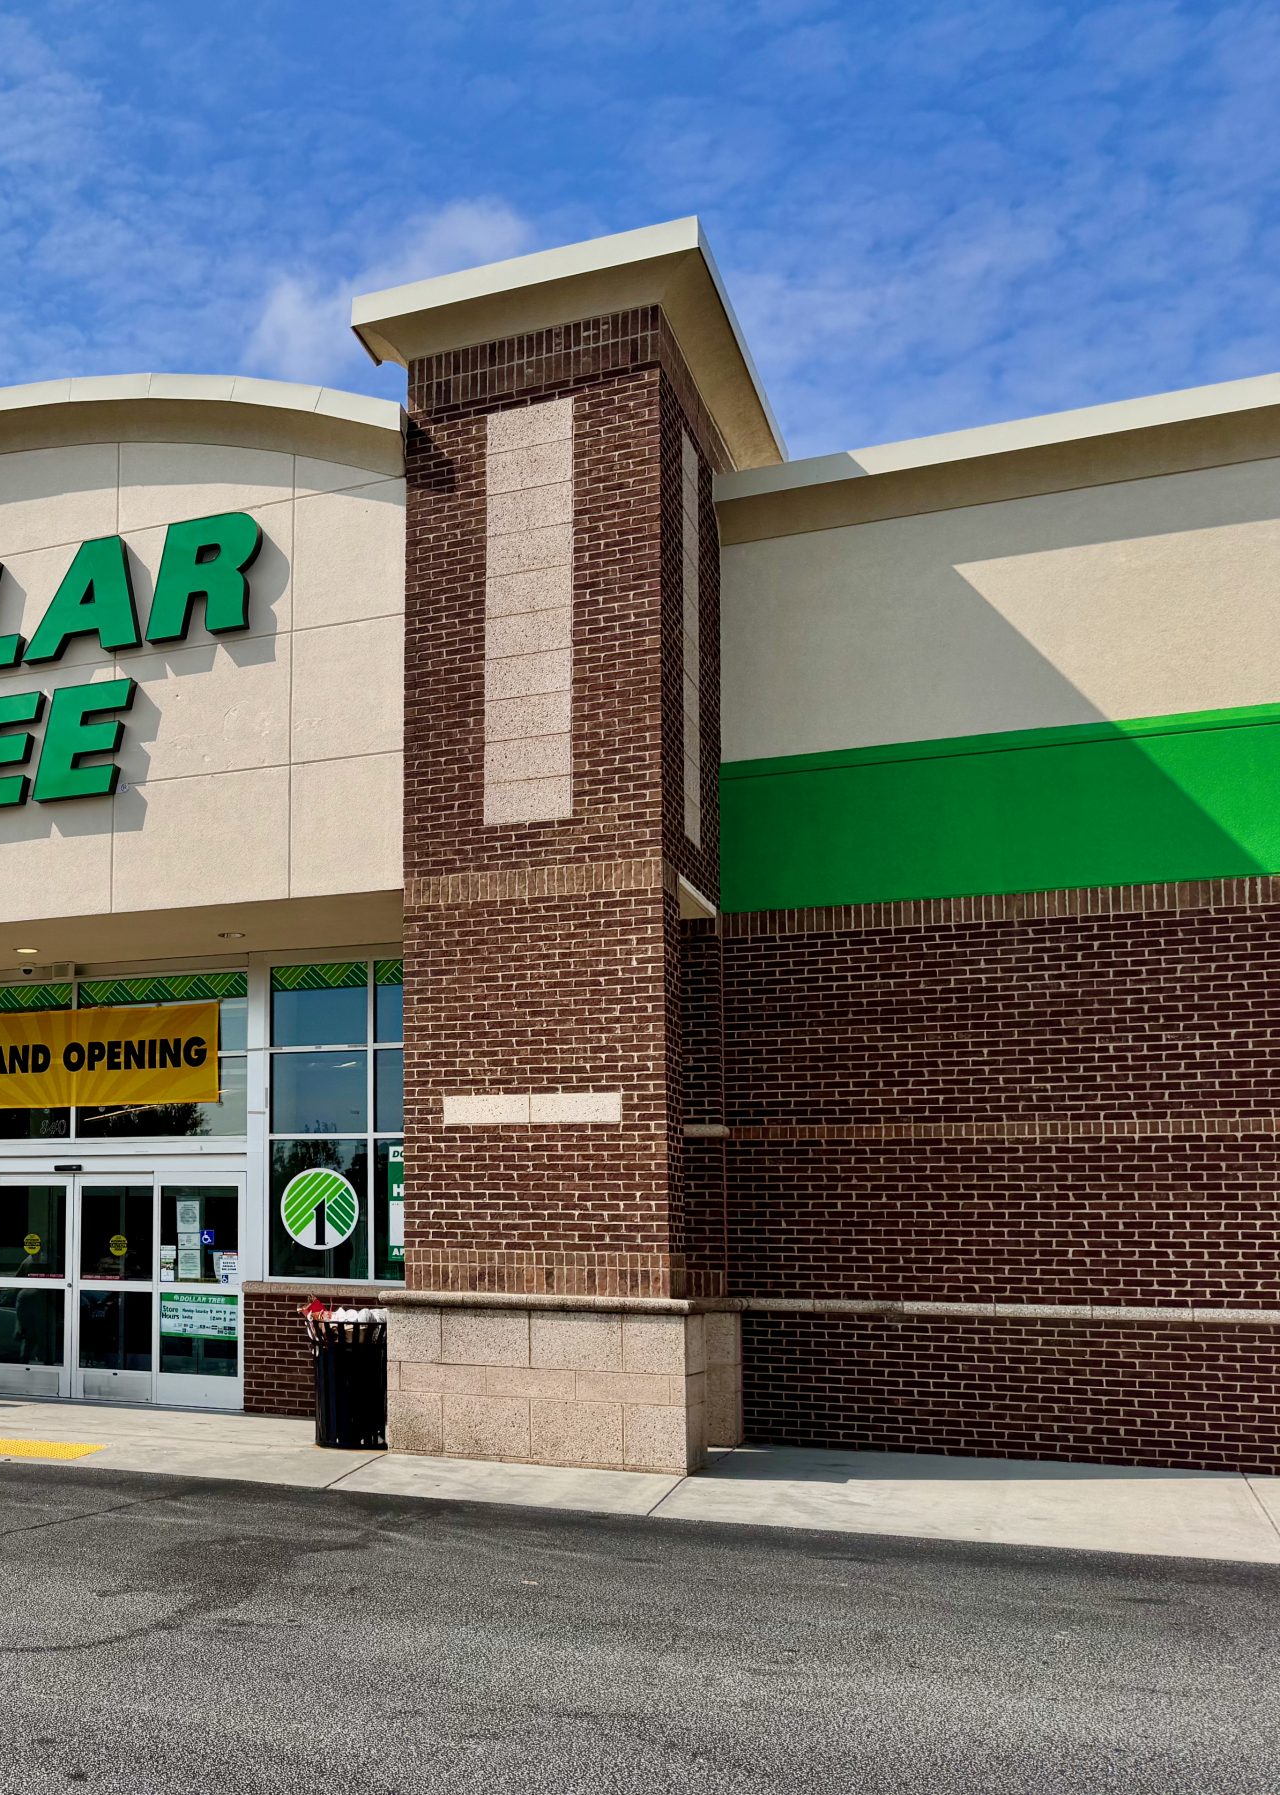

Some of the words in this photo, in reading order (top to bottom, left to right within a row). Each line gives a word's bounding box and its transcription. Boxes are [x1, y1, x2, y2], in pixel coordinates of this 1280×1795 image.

[62, 1036, 208, 1072] OPENING
[180, 1295, 208, 1303] DOLLAR
[163, 1305, 179, 1313] Store
[161, 1312, 180, 1320] Hours
